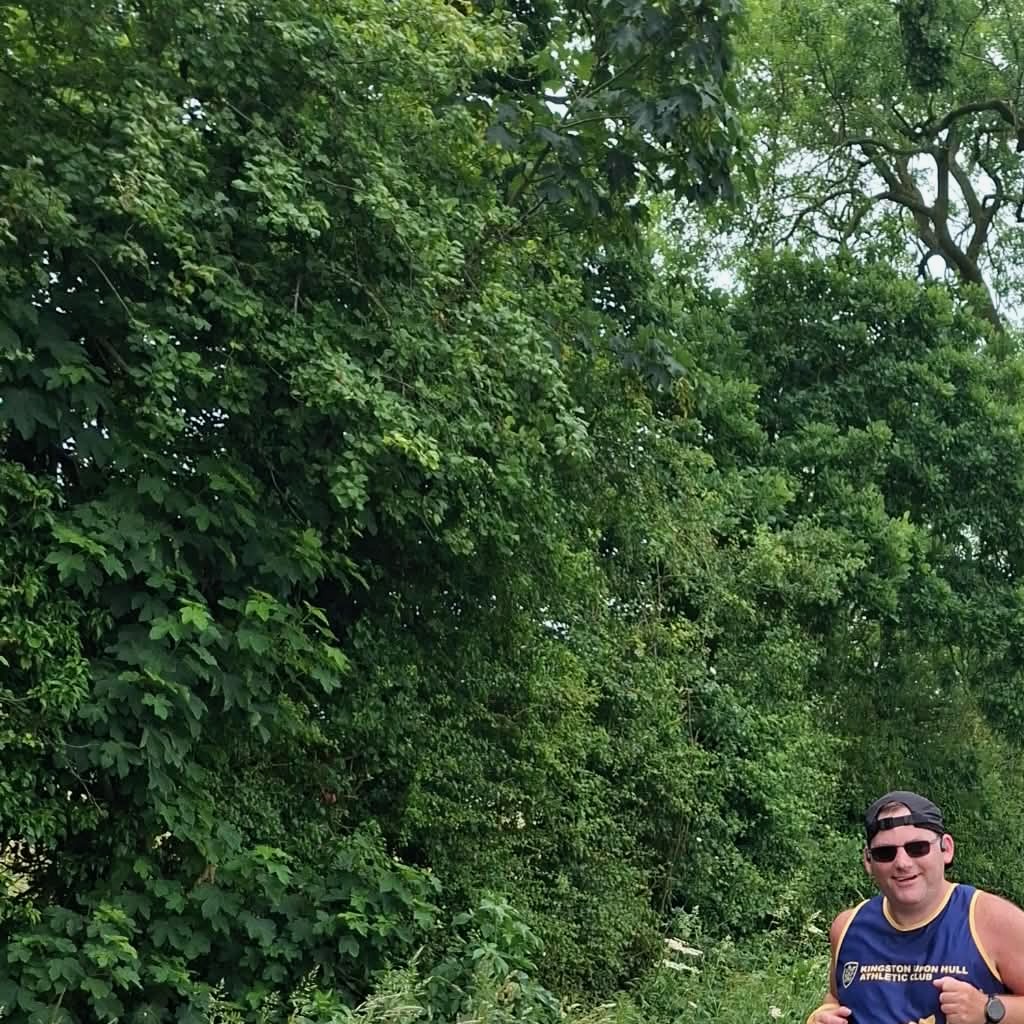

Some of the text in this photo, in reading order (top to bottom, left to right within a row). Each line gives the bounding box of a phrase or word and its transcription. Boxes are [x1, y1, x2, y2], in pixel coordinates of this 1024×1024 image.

[860, 965, 911, 973] KINGSTON
[941, 965, 968, 975] HULL
[860, 973, 908, 982] ATHLETIC
